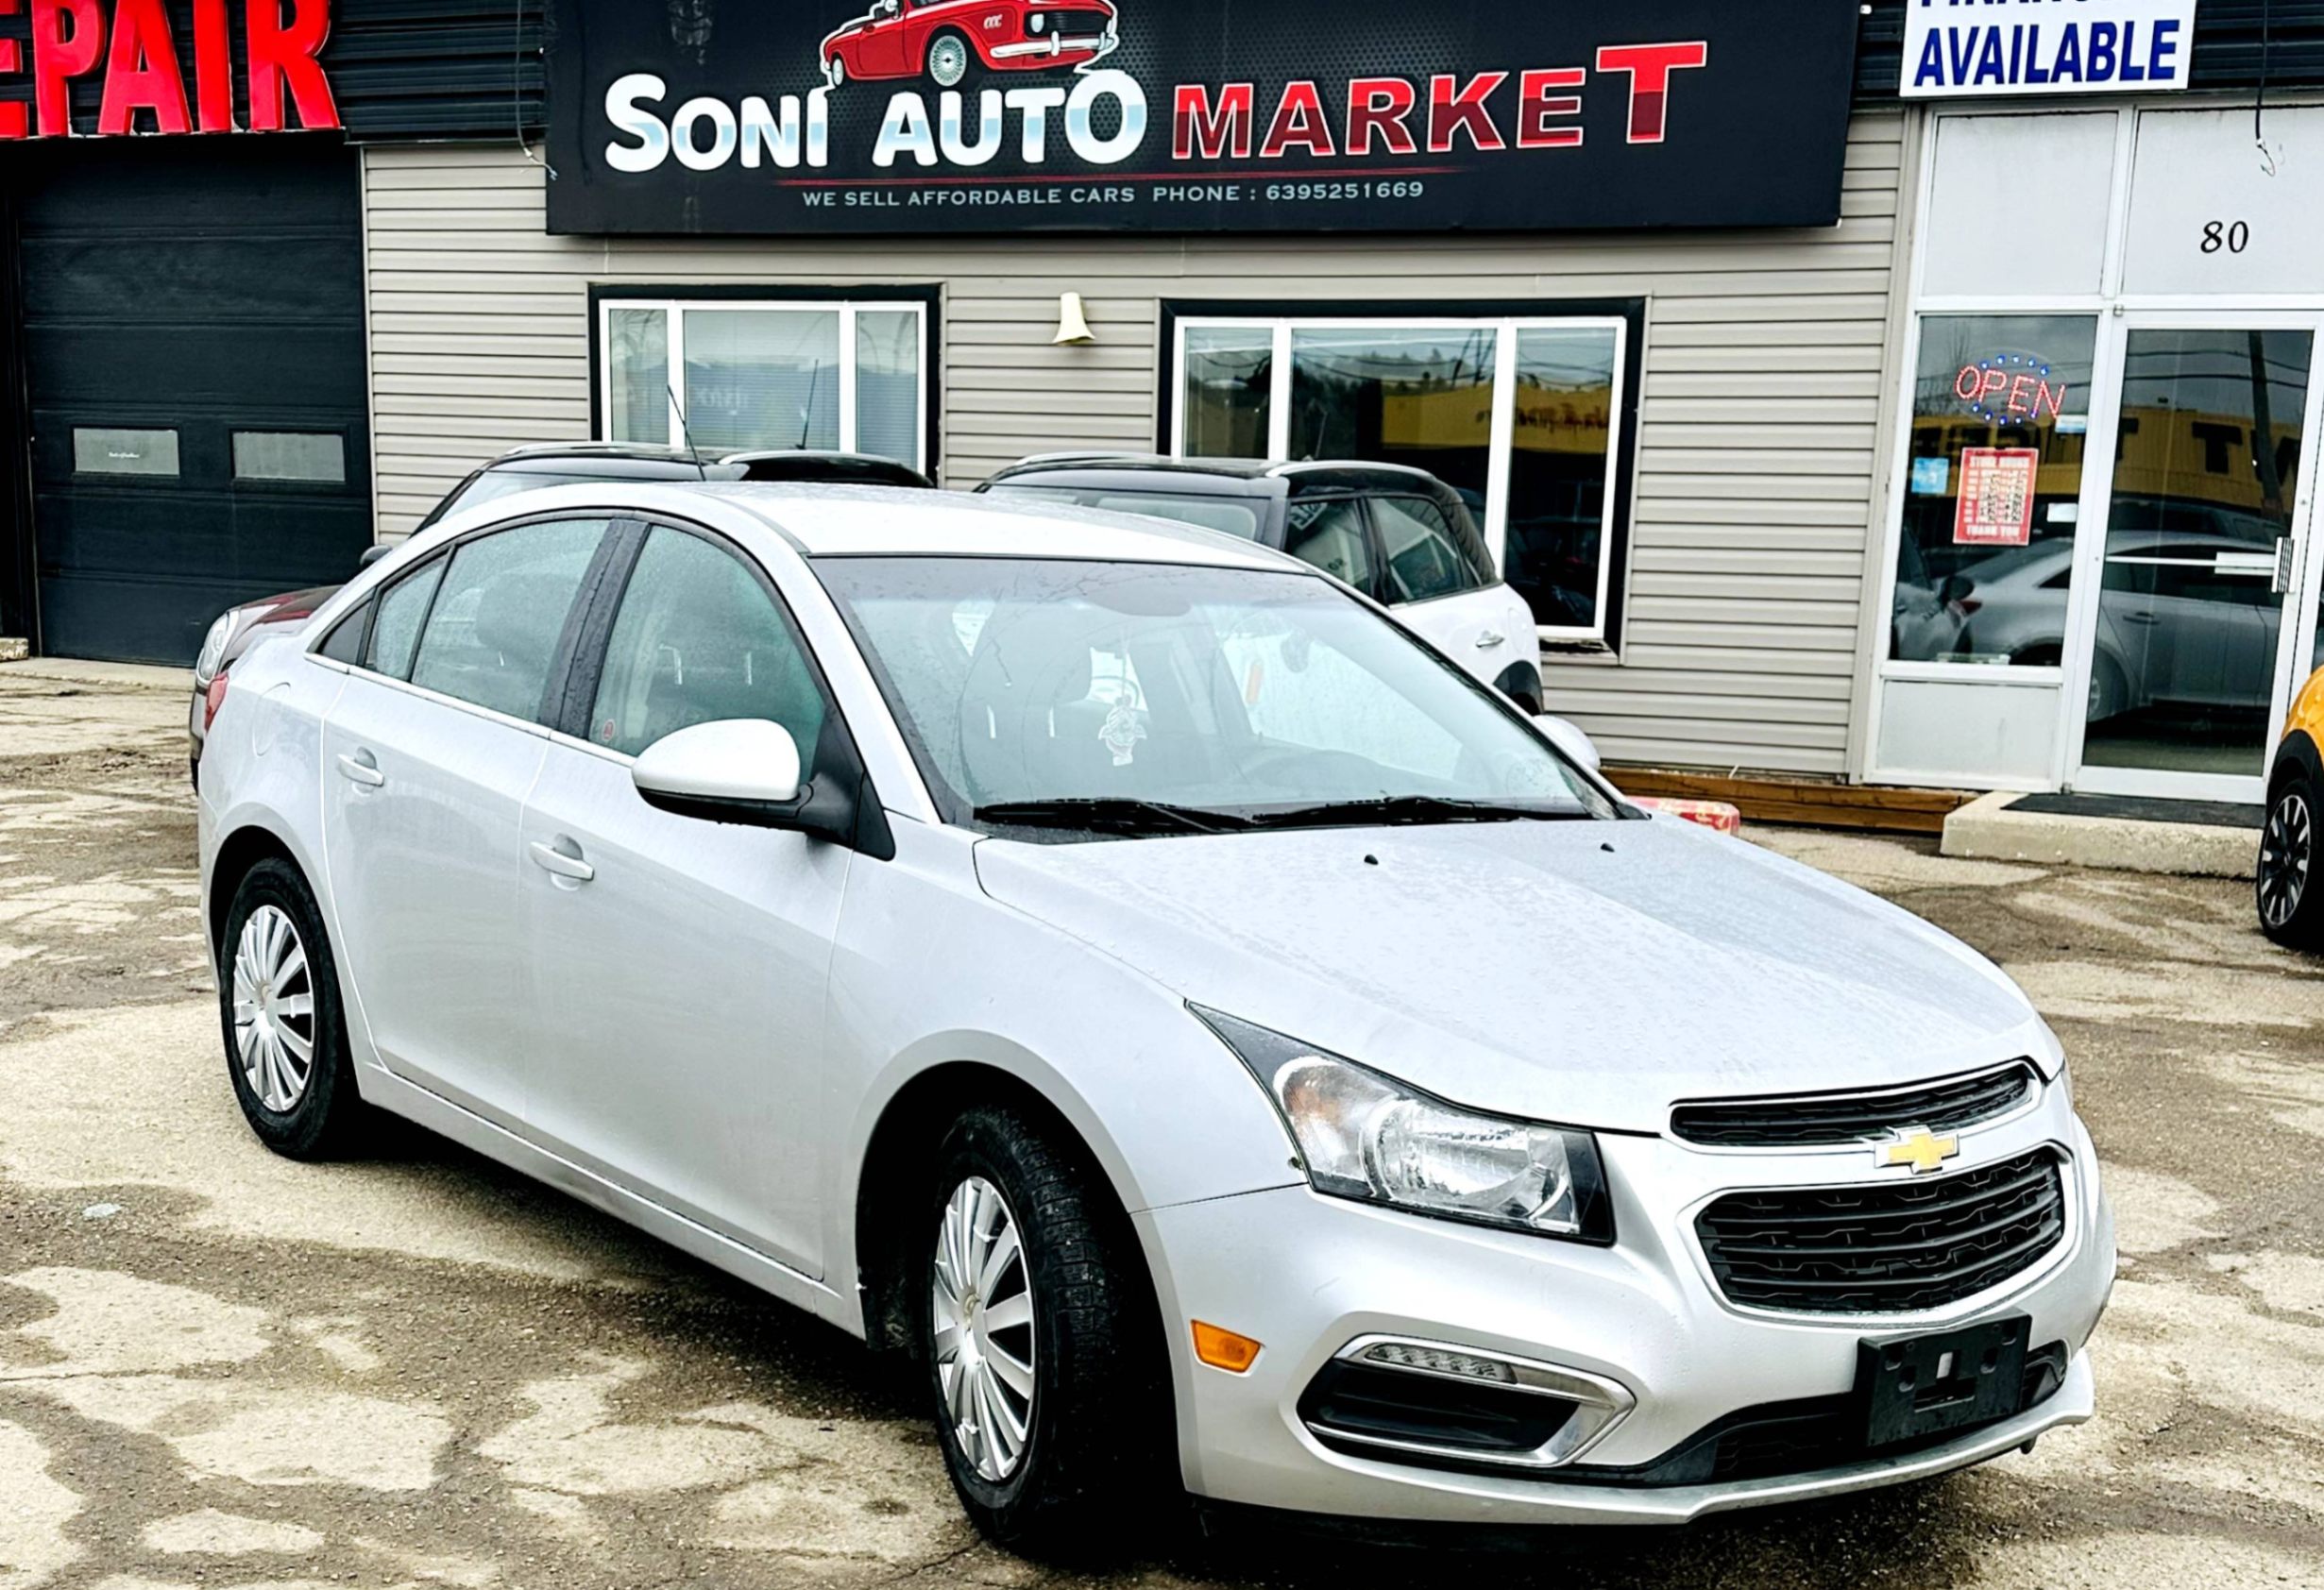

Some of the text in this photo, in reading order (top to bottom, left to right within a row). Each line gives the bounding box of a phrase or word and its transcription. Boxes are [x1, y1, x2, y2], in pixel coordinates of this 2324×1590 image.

[1913, 19, 2180, 87] AVAILABLE
[605, 42, 1707, 173] SONI AUTO MARKET
[803, 181, 1424, 206] WE SELL AFFORDABLE CARS PHONE : 6395251669
[2200, 220, 2248, 254] 80
[1955, 364, 2066, 419] OPEN
